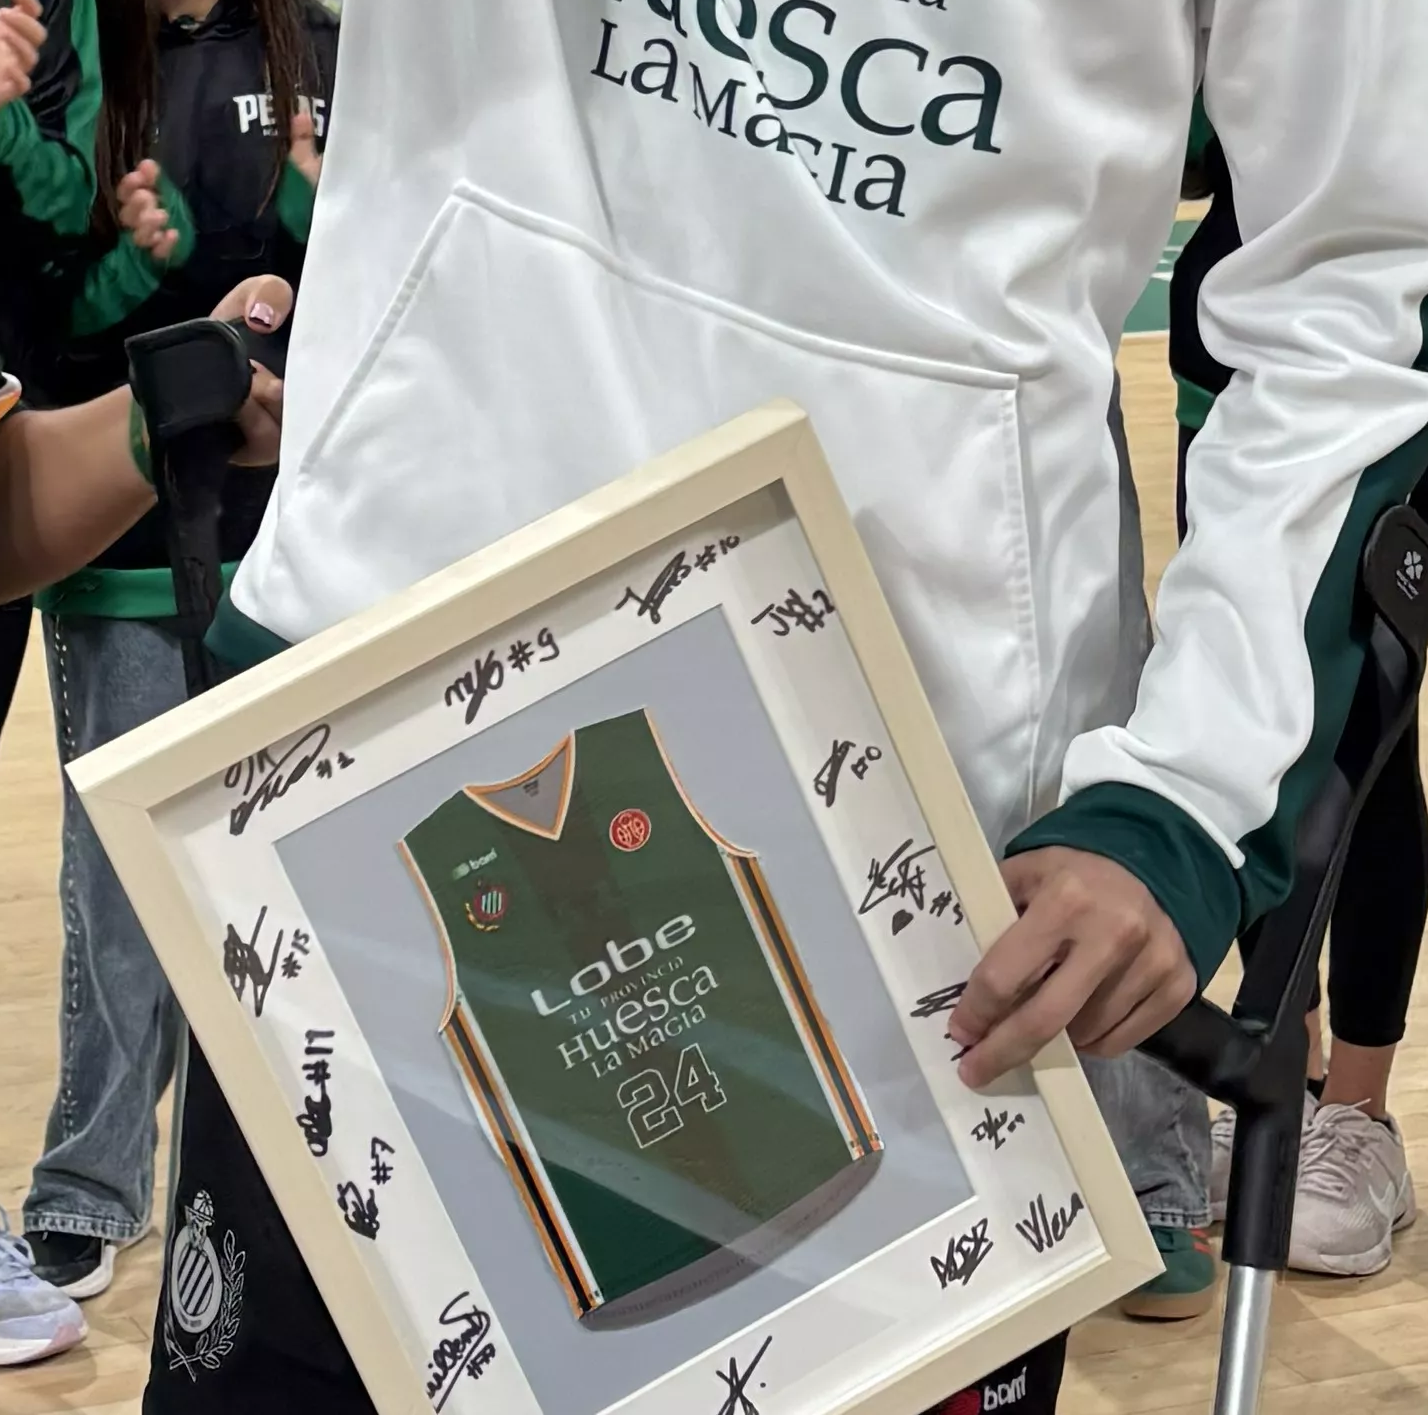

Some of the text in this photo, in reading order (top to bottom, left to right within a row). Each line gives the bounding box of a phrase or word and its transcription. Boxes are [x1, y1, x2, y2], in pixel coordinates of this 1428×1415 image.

[590, 18, 679, 104] La
[529, 913, 697, 1017] Lobe
[556, 962, 720, 1071] Huesca
[616, 1041, 727, 1149] 24
